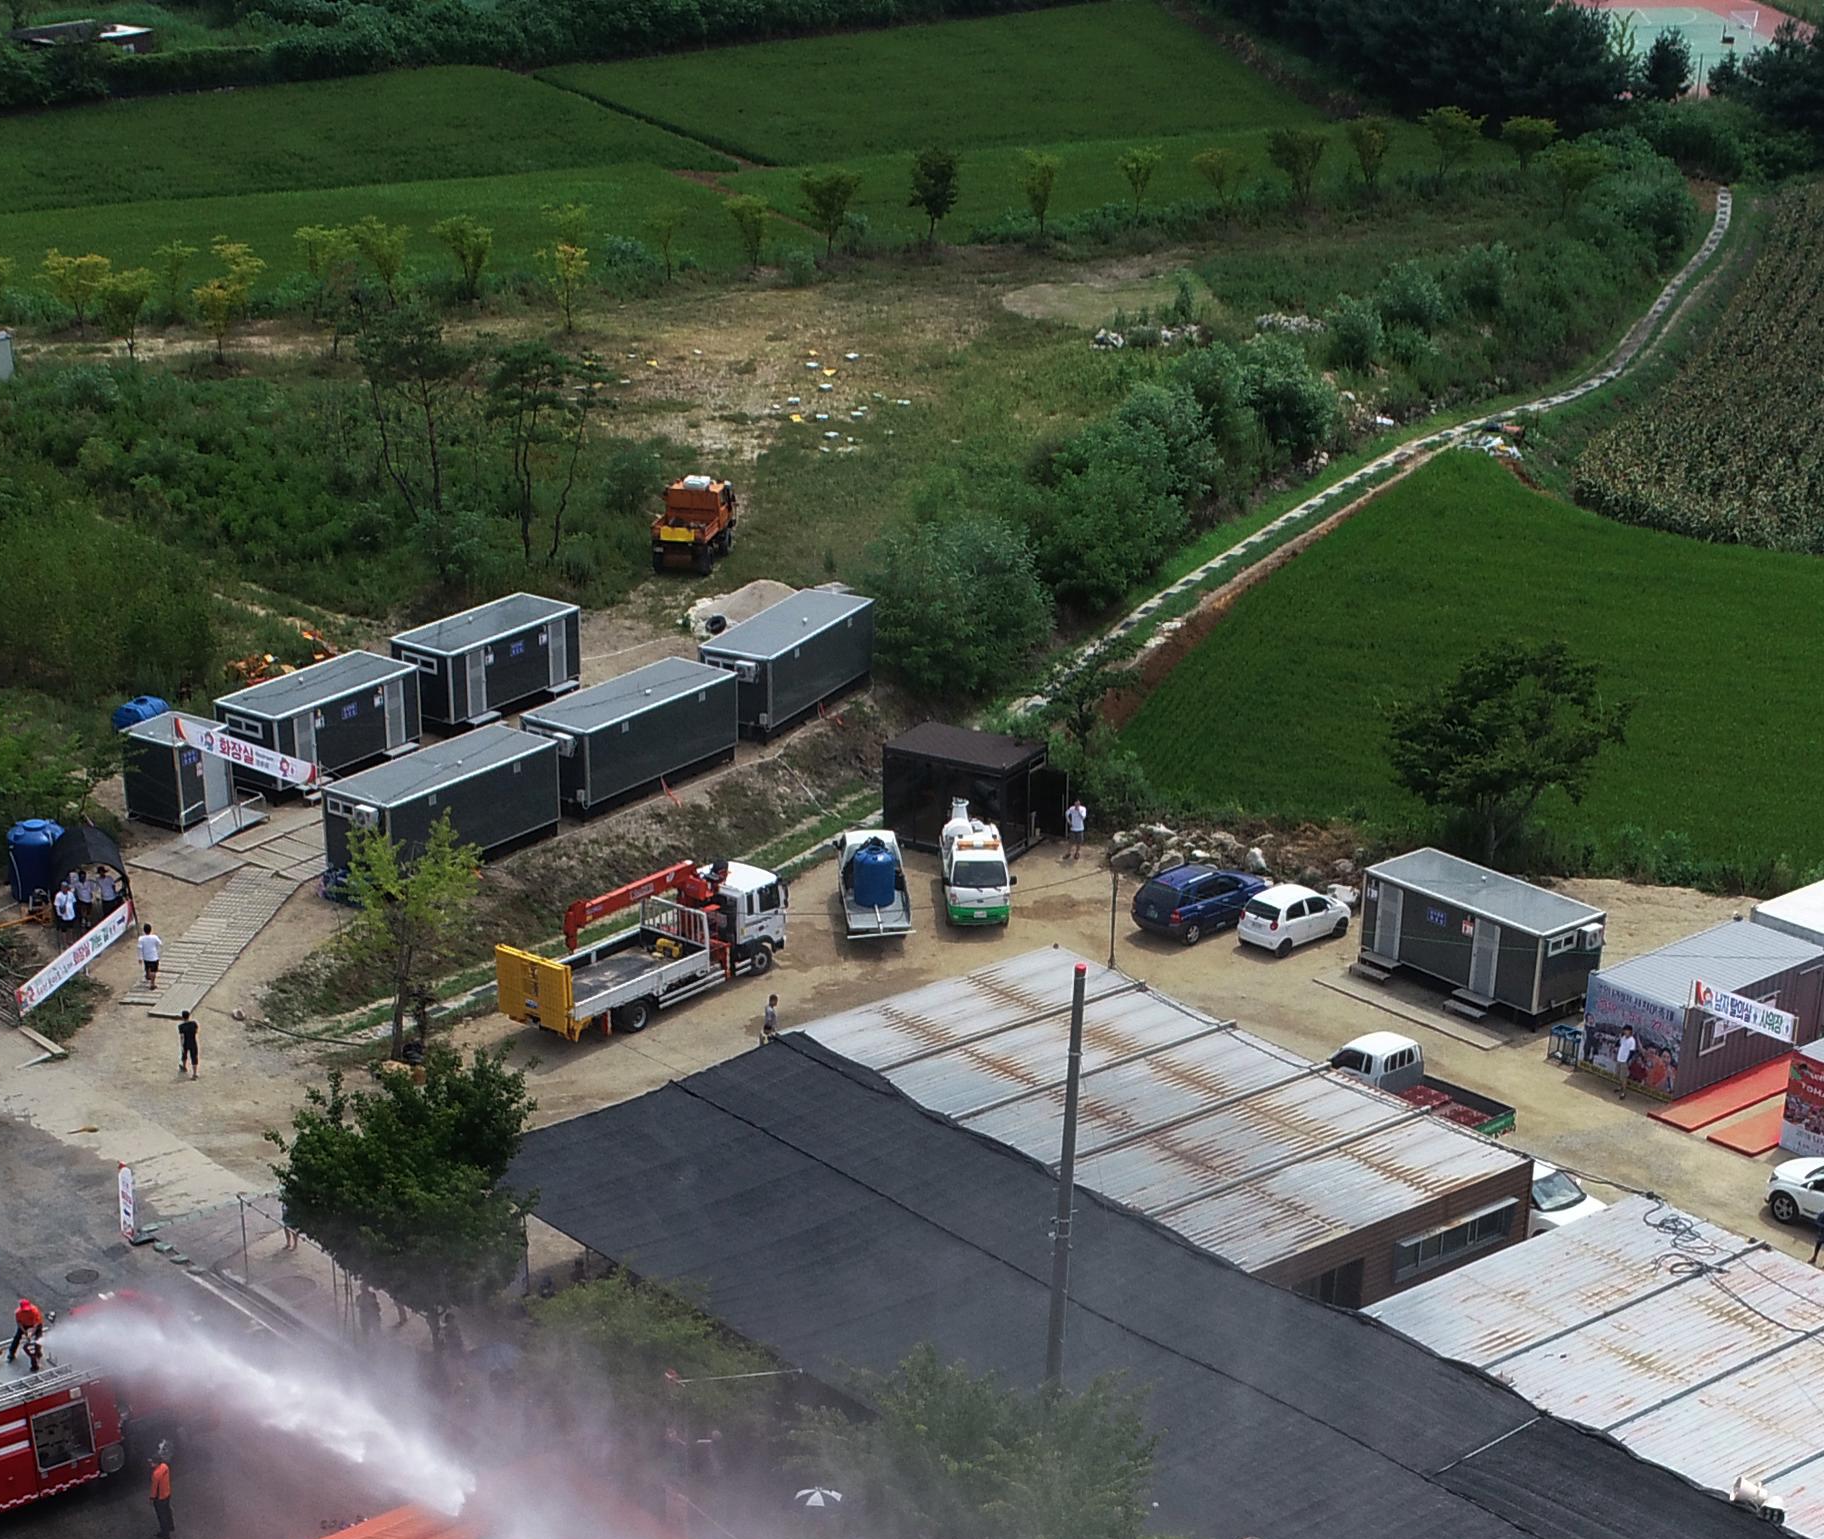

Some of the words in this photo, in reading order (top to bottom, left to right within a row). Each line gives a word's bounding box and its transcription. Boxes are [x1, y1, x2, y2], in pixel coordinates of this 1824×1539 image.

[219, 737, 255, 765] 화장실
[1715, 991, 1730, 1015] 남자
[1729, 996, 1752, 1023] 탈의실
